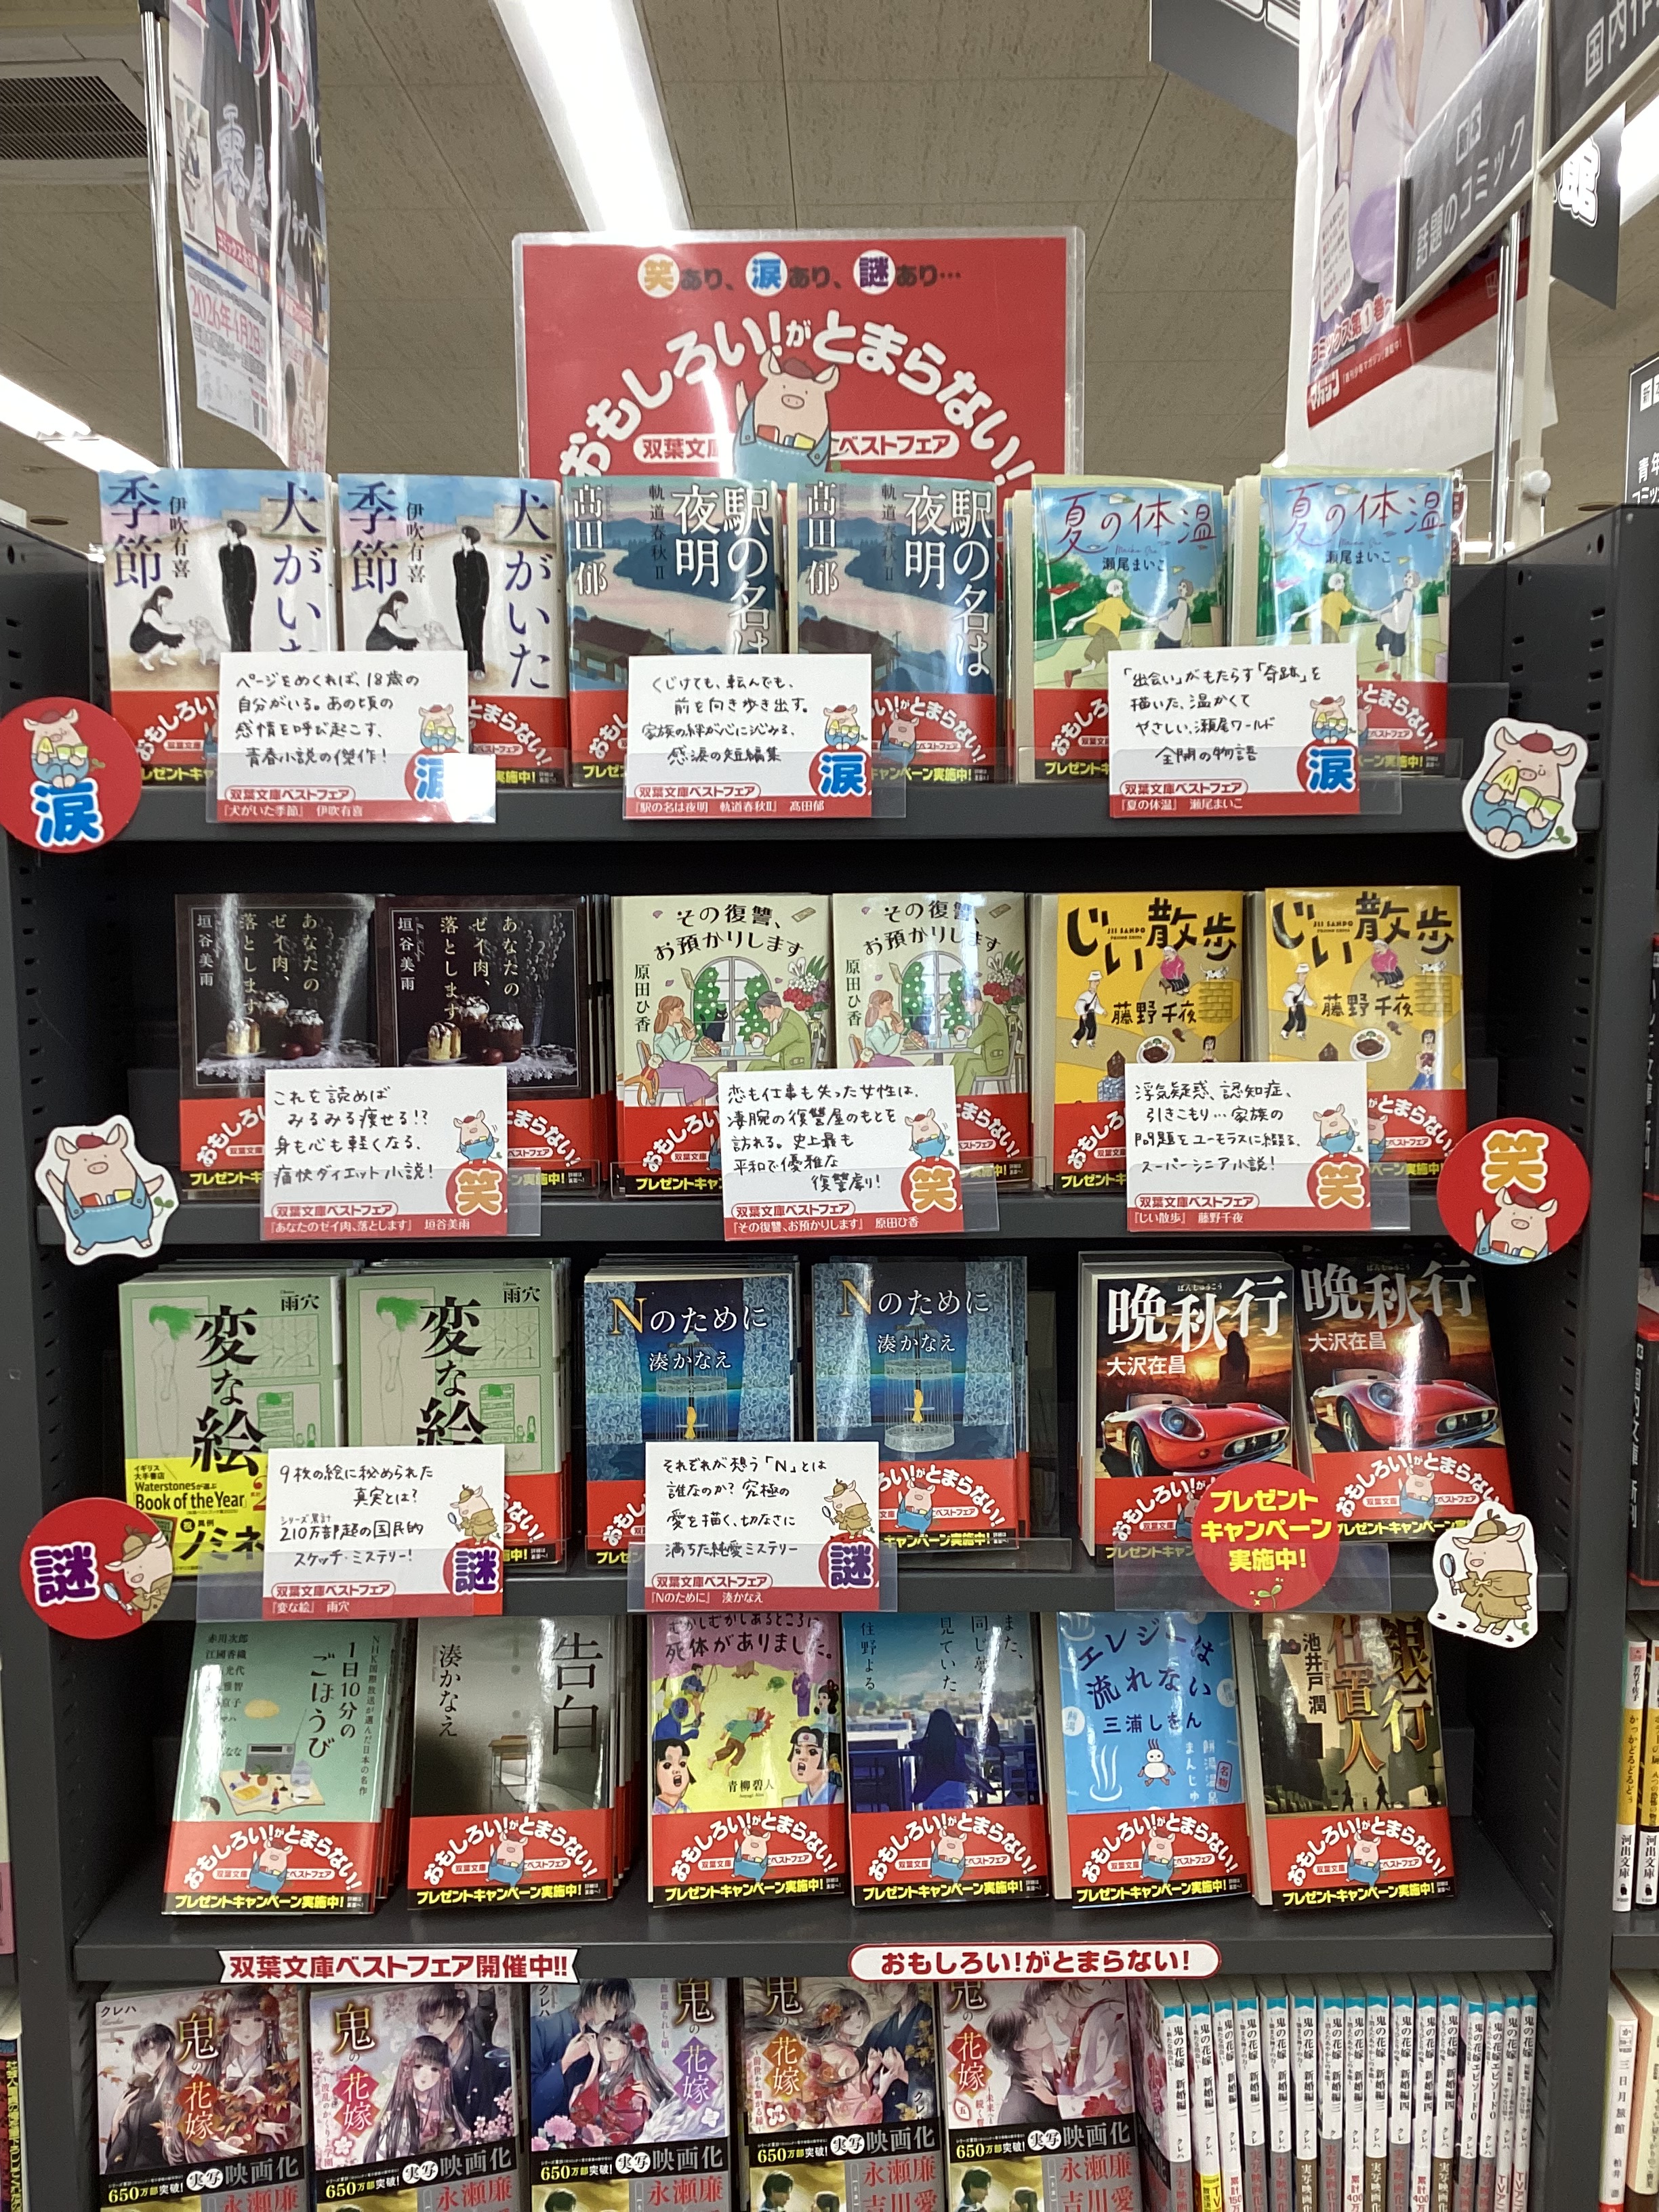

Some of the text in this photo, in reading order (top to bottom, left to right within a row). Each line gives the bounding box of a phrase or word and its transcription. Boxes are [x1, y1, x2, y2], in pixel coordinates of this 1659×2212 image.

[838, 435, 950, 456] ベストフェア
[1048, 491, 1216, 564] 夏の体温
[1280, 482, 1445, 548] 夏の体温
[108, 476, 161, 589] 季節
[169, 495, 190, 578] 伊吹有喜
[348, 481, 397, 593] 季節
[405, 501, 426, 583] 伊吹有喜
[673, 487, 722, 587] 夜明
[902, 485, 947, 589] 夜明
[1103, 557, 1166, 572] 瀬尾まいこ
[1327, 550, 1391, 565] 瀬尾まいこ
[505, 488, 551, 689] 犬がいた
[950, 491, 993, 677] 駅の名は
[1130, 693, 1250, 712] 描いた、温かくて
[245, 747, 387, 767] 青春小説の傑作!
[667, 745, 781, 765] 感涙の短編集
[1155, 744, 1258, 765] 全開の物語
[821, 754, 863, 796] 涙
[1310, 747, 1355, 791] 涙
[229, 787, 350, 802] 双葉文庫ベストフェア
[639, 785, 755, 798] 双葉文庫ベストフェア
[1125, 782, 1242, 796] 双葉文庫ベストフェア
[35, 784, 101, 844] 涙
[1189, 798, 1244, 810] 瀬尾まいこ
[197, 914, 213, 986] 垣谷美雨
[302, 913, 319, 992] あなたの
[397, 916, 415, 990] 垣谷美雨
[653, 931, 804, 962] お預かりします
[863, 927, 1001, 956] お預かりします
[502, 916, 520, 997] あなたの
[634, 964, 651, 1033] 原田ひ香
[846, 958, 862, 1027] 原田ひ香
[1111, 1002, 1197, 1025] 藤野千夜
[1321, 993, 1414, 1019] 藤野千夜
[274, 1086, 390, 1105] これを読めば
[288, 1107, 428, 1128] みるみる痩せる!?
[733, 1153, 838, 1176] 平和で優雅な
[1142, 1156, 1274, 1173] スーパーシニア小説!
[1485, 1132, 1545, 1190] 笑
[273, 1162, 433, 1188] 痛快ダイエット小説!
[811, 1172, 880, 1193] 復讐劇!
[1318, 1162, 1361, 1206] 笑
[458, 1169, 504, 1215] 笑
[913, 1168, 957, 1212] 笑
[1139, 1195, 1254, 1209] 双葉文庫ベストフェア
[277, 1204, 392, 1217] 双葉文庫ベストフェア
[736, 1204, 850, 1218] 双葉文庫ベストフェア
[875, 1216, 919, 1230] 原田ひ香
[424, 1218, 470, 1230] 垣谷美雨
[281, 1294, 319, 1311] 雨穴
[502, 1286, 540, 1303] 雨穴
[839, 1279, 990, 1317] Nのために
[1301, 1260, 1476, 1330] 晩秋行
[611, 1297, 768, 1336] Nのために
[1107, 1275, 1288, 1353] 晩秋行
[878, 1334, 956, 1353] 湊かなえ
[1308, 1332, 1387, 1353] 大沢在昌
[649, 1351, 732, 1372] 湊かなえ
[1106, 1355, 1186, 1377] 大沢在昌
[192, 1305, 267, 1474] 変な絵
[279, 1463, 434, 1483] 9枚の絵に秘められた
[174, 1493, 186, 1509] of
[190, 1492, 213, 1508] the
[354, 1486, 418, 1507] 真実とは?
[1210, 1490, 1319, 1513] プレゼント
[1200, 1519, 1332, 1544] キャンペーン
[665, 1541, 798, 1559] 満ちた純愛ミステリー
[1229, 1549, 1306, 1572] 実施中!
[34, 1545, 96, 1603] 謎
[455, 1549, 500, 1593] 謎
[830, 1545, 873, 1588] 謎
[276, 1583, 390, 1598] 双葉文庫ベストフェア
[656, 1576, 768, 1589] 双葉文庫ベストフェア
[861, 1622, 876, 1690] 住野よる
[940, 1617, 956, 1692] 見ていた
[1078, 1618, 1214, 1671] エレジーは
[1302, 1633, 1328, 1715] 池井戸潤
[439, 1643, 462, 1738] 湊かなえ
[553, 1631, 602, 1755] 告白
[1086, 1666, 1212, 1710] 流れない
[308, 1652, 335, 1759] ごほうび
[1103, 1712, 1202, 1734] 三浦しをん
[728, 1780, 775, 1793] 青柳碧人
[175, 1893, 344, 1910] プレゼントキャンペーン実施中!
[417, 1884, 581, 1905] プレゼントキャンペーン実施中!
[665, 1879, 823, 1902] プレゼントキャンペーン実施中!
[863, 1880, 1023, 1902] プレゼントキャンペーン実施中!
[1077, 1880, 1227, 1902] プレゼントキャンペーン実施中!
[1284, 1883, 1435, 1906] プレゼントキャンペーン実施中!
[230, 1954, 567, 1981] 双葉文庫ベストフェア開催中!!
[882, 1950, 1189, 1975] おもしろい!がとまらない!
[100, 2004, 138, 2018] クレハ
